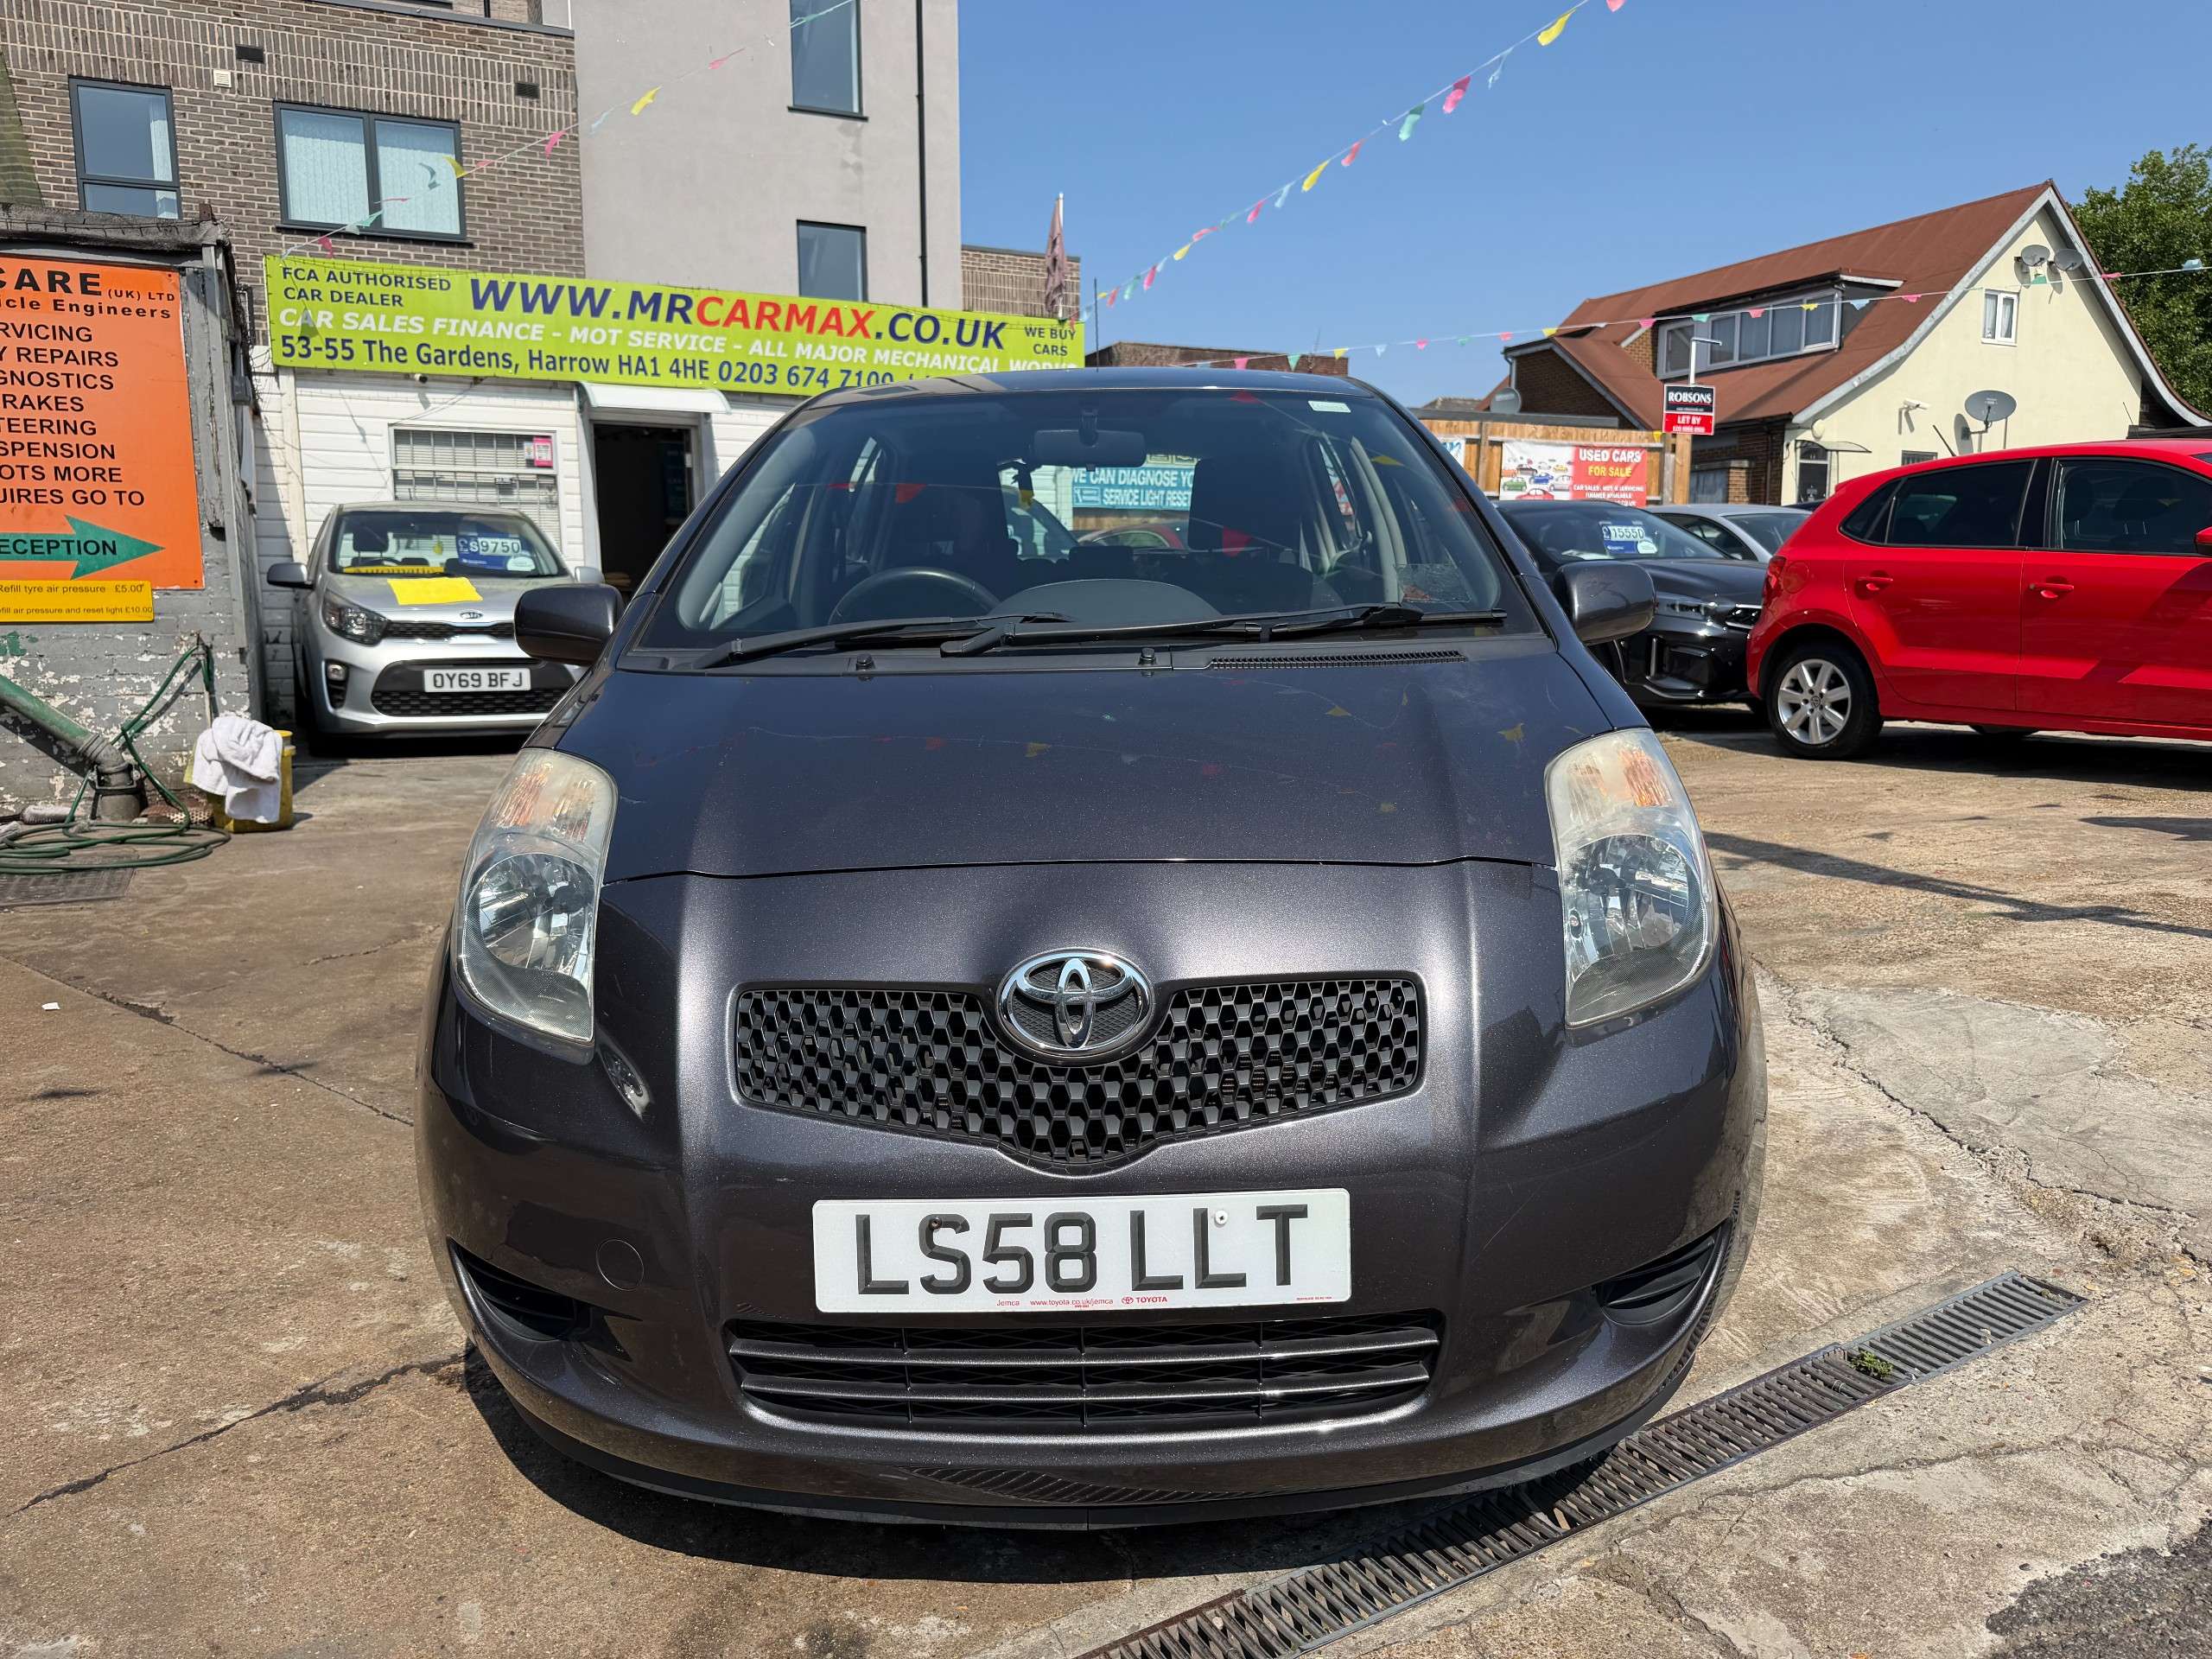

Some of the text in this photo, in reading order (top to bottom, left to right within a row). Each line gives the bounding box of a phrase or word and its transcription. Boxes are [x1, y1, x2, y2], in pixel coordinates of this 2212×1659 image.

[0, 267, 175, 302] ARE (UK) LTD
[283, 267, 452, 291] FCA AUTHORISED
[283, 286, 404, 308] CAR DEALER
[0, 296, 171, 320] cle Engineers
[471, 278, 1008, 350] WWW.MRCARMAX.CO.UK
[279, 308, 334, 329] CAR
[342, 312, 424, 334] SALES
[433, 317, 545, 341] FINANCE
[569, 326, 622, 346] MOT
[628, 330, 727, 353] SERVICE
[748, 340, 788, 358] ALL
[795, 342, 866, 364] MAJOR
[874, 348, 999, 372] MECHANICAL
[1025, 326, 1077, 340] WE BUY
[16, 346, 119, 367] REPAIRS
[1033, 344, 1068, 357] CARS
[282, 335, 354, 360] 53-55
[362, 340, 409, 364] The
[416, 342, 519, 374] Gardens,
[528, 349, 610, 374] Harrow
[619, 354, 661, 378] HA1
[670, 358, 710, 380] 4HE
[718, 360, 778, 385] 0203
[787, 365, 830, 388] 674
[2, 393, 85, 411] RAKES
[1669, 391, 1712, 404] ROBSONS
[1677, 415, 1701, 425] LET BY
[1579, 448, 1642, 463] USED CARS
[0, 464, 123, 483] OTS MORE
[1072, 468, 1086, 483] WE
[1090, 469, 1114, 485] CAN
[1118, 469, 1178, 487] DIAGNOSE
[1588, 466, 1632, 478] FOR SALE
[72, 489, 106, 505] GO
[113, 490, 144, 506] TO
[1103, 488, 1139, 505] SERVICE
[1141, 489, 1166, 506] LIGHT
[24, 586, 43, 595] tyre
[433, 672, 523, 689] OY69 BFJ
[855, 1204, 1307, 1296] LS58 LLT
